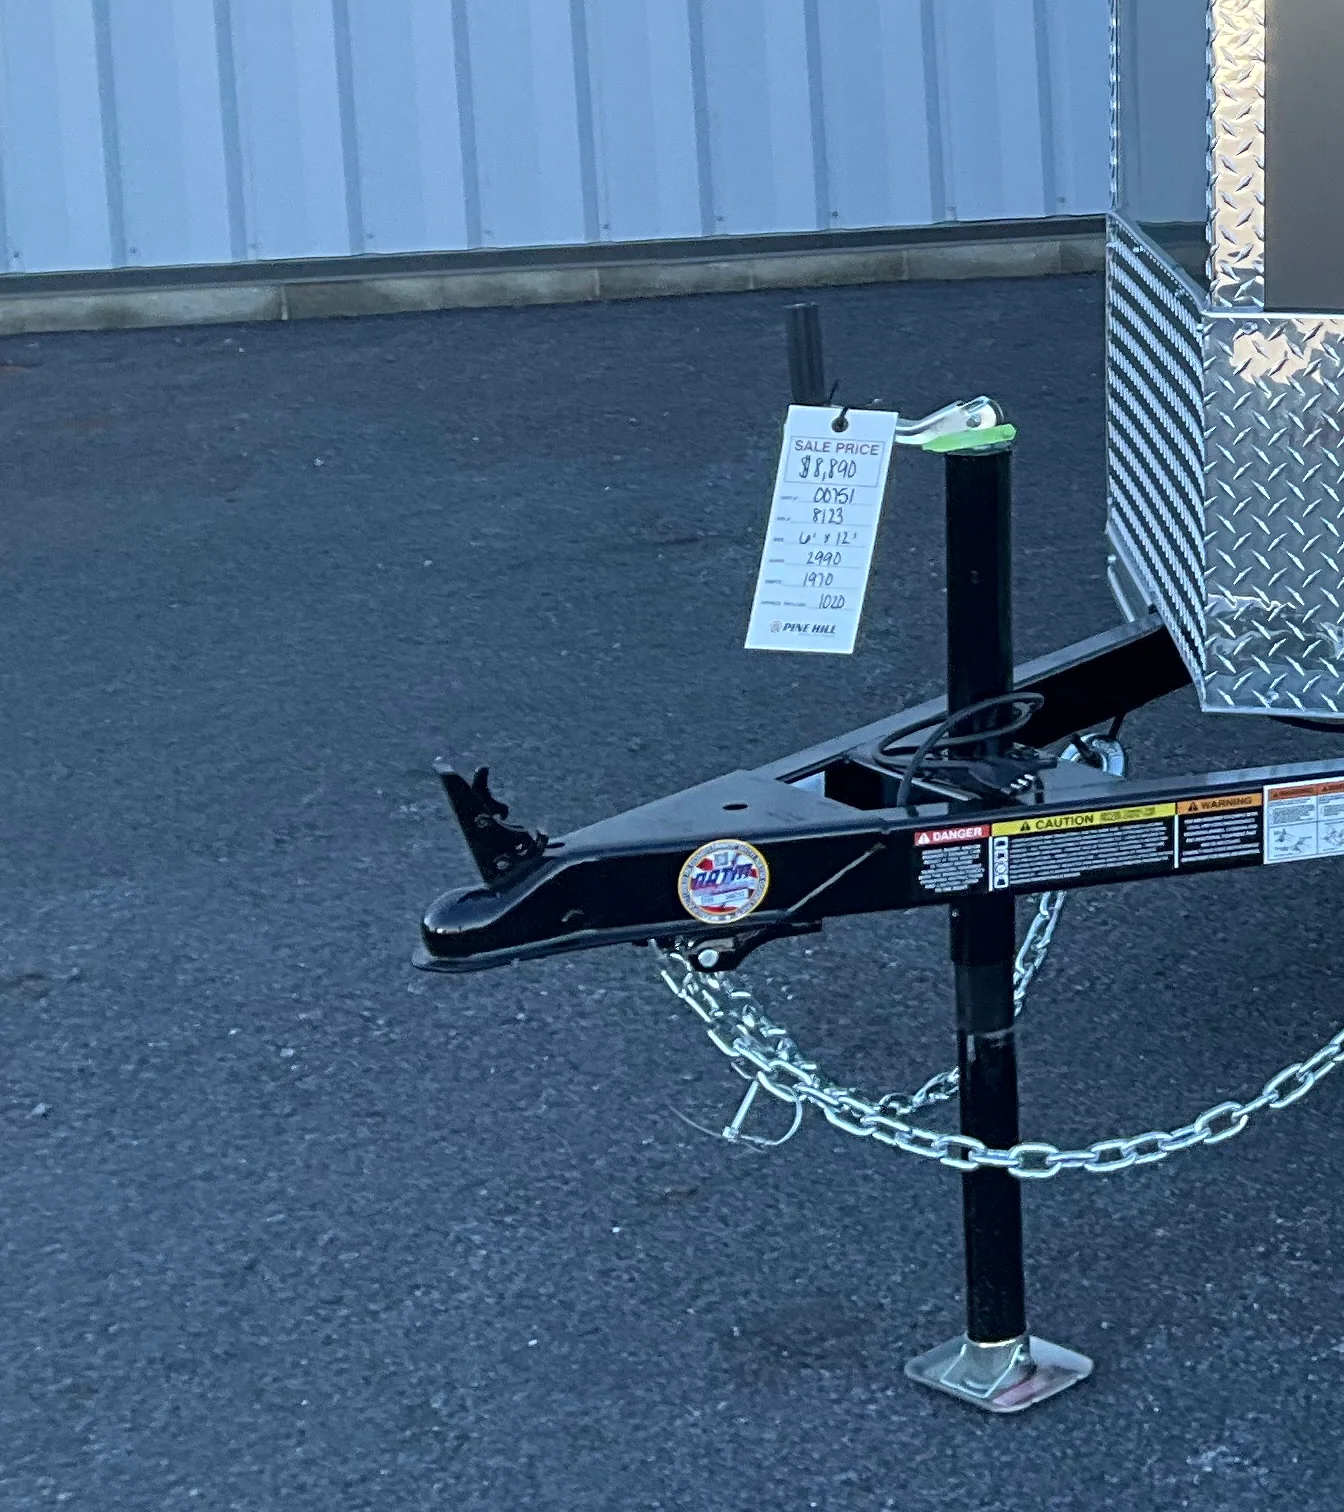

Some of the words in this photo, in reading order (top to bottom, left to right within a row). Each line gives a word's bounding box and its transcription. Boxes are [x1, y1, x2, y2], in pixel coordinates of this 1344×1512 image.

[794, 439, 832, 453] SALE
[835, 441, 880, 456] PRICE
[799, 454, 857, 482] $8,890
[812, 506, 844, 525] 8123
[805, 550, 842, 566] 2990
[802, 571, 834, 588] 1970
[818, 593, 846, 610] 1020
[811, 623, 837, 635] HILL
[1201, 796, 1253, 810] WARNING
[1034, 813, 1095, 831] CAUTION
[932, 826, 984, 843] DANGER
